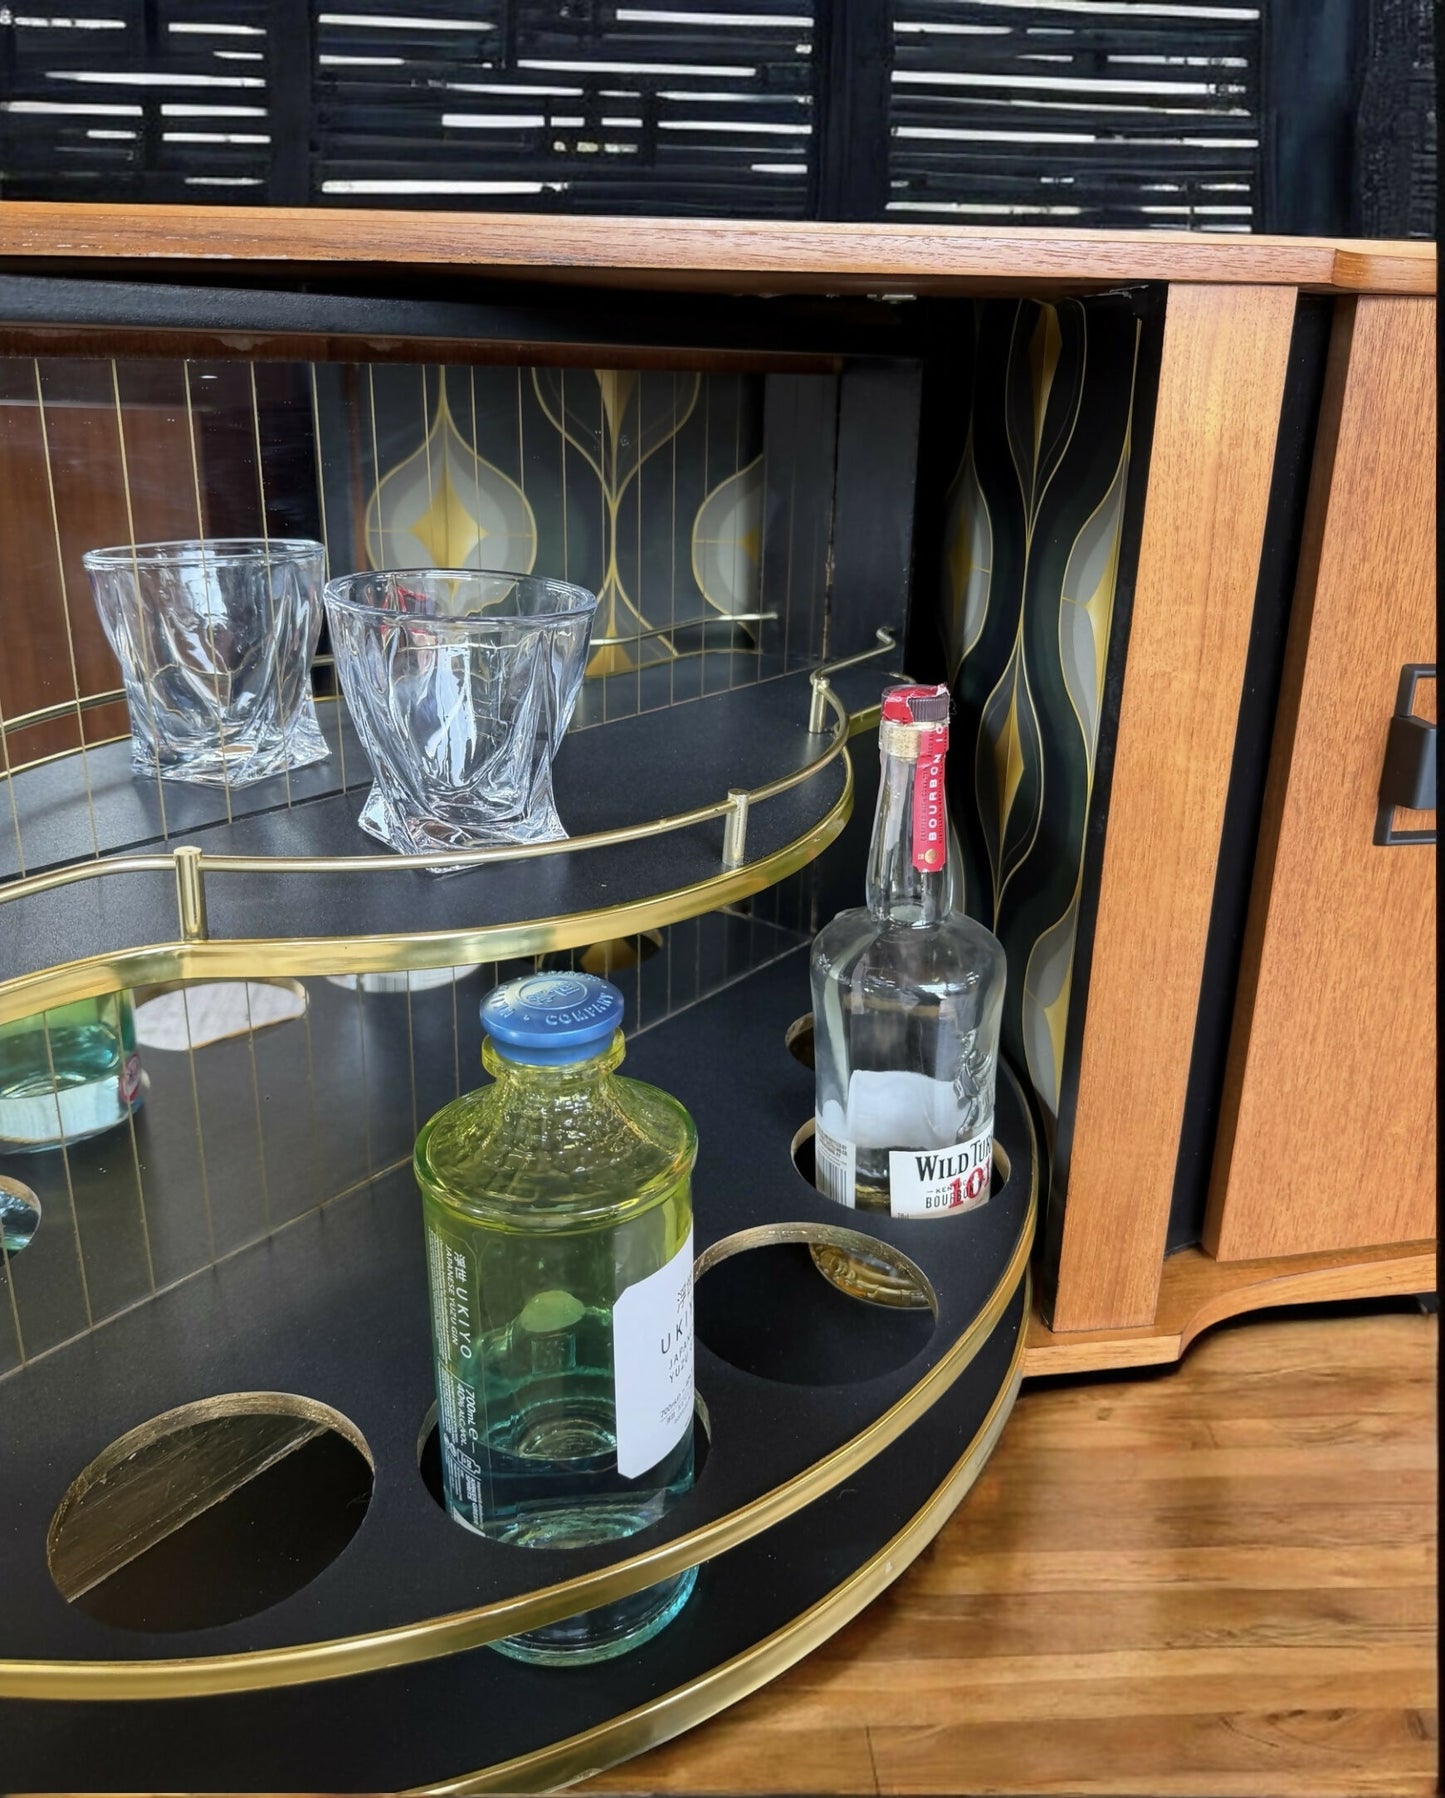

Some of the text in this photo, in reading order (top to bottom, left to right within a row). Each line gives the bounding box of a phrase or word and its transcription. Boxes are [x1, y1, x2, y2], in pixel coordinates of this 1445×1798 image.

[928, 754, 942, 841] BOURBON
[545, 992, 615, 1026] COMPANY
[915, 1152, 969, 1182] WILD
[445, 1244, 459, 1346] JAPANESE YUZU GIN
[455, 1286, 472, 1359] UKIYO
